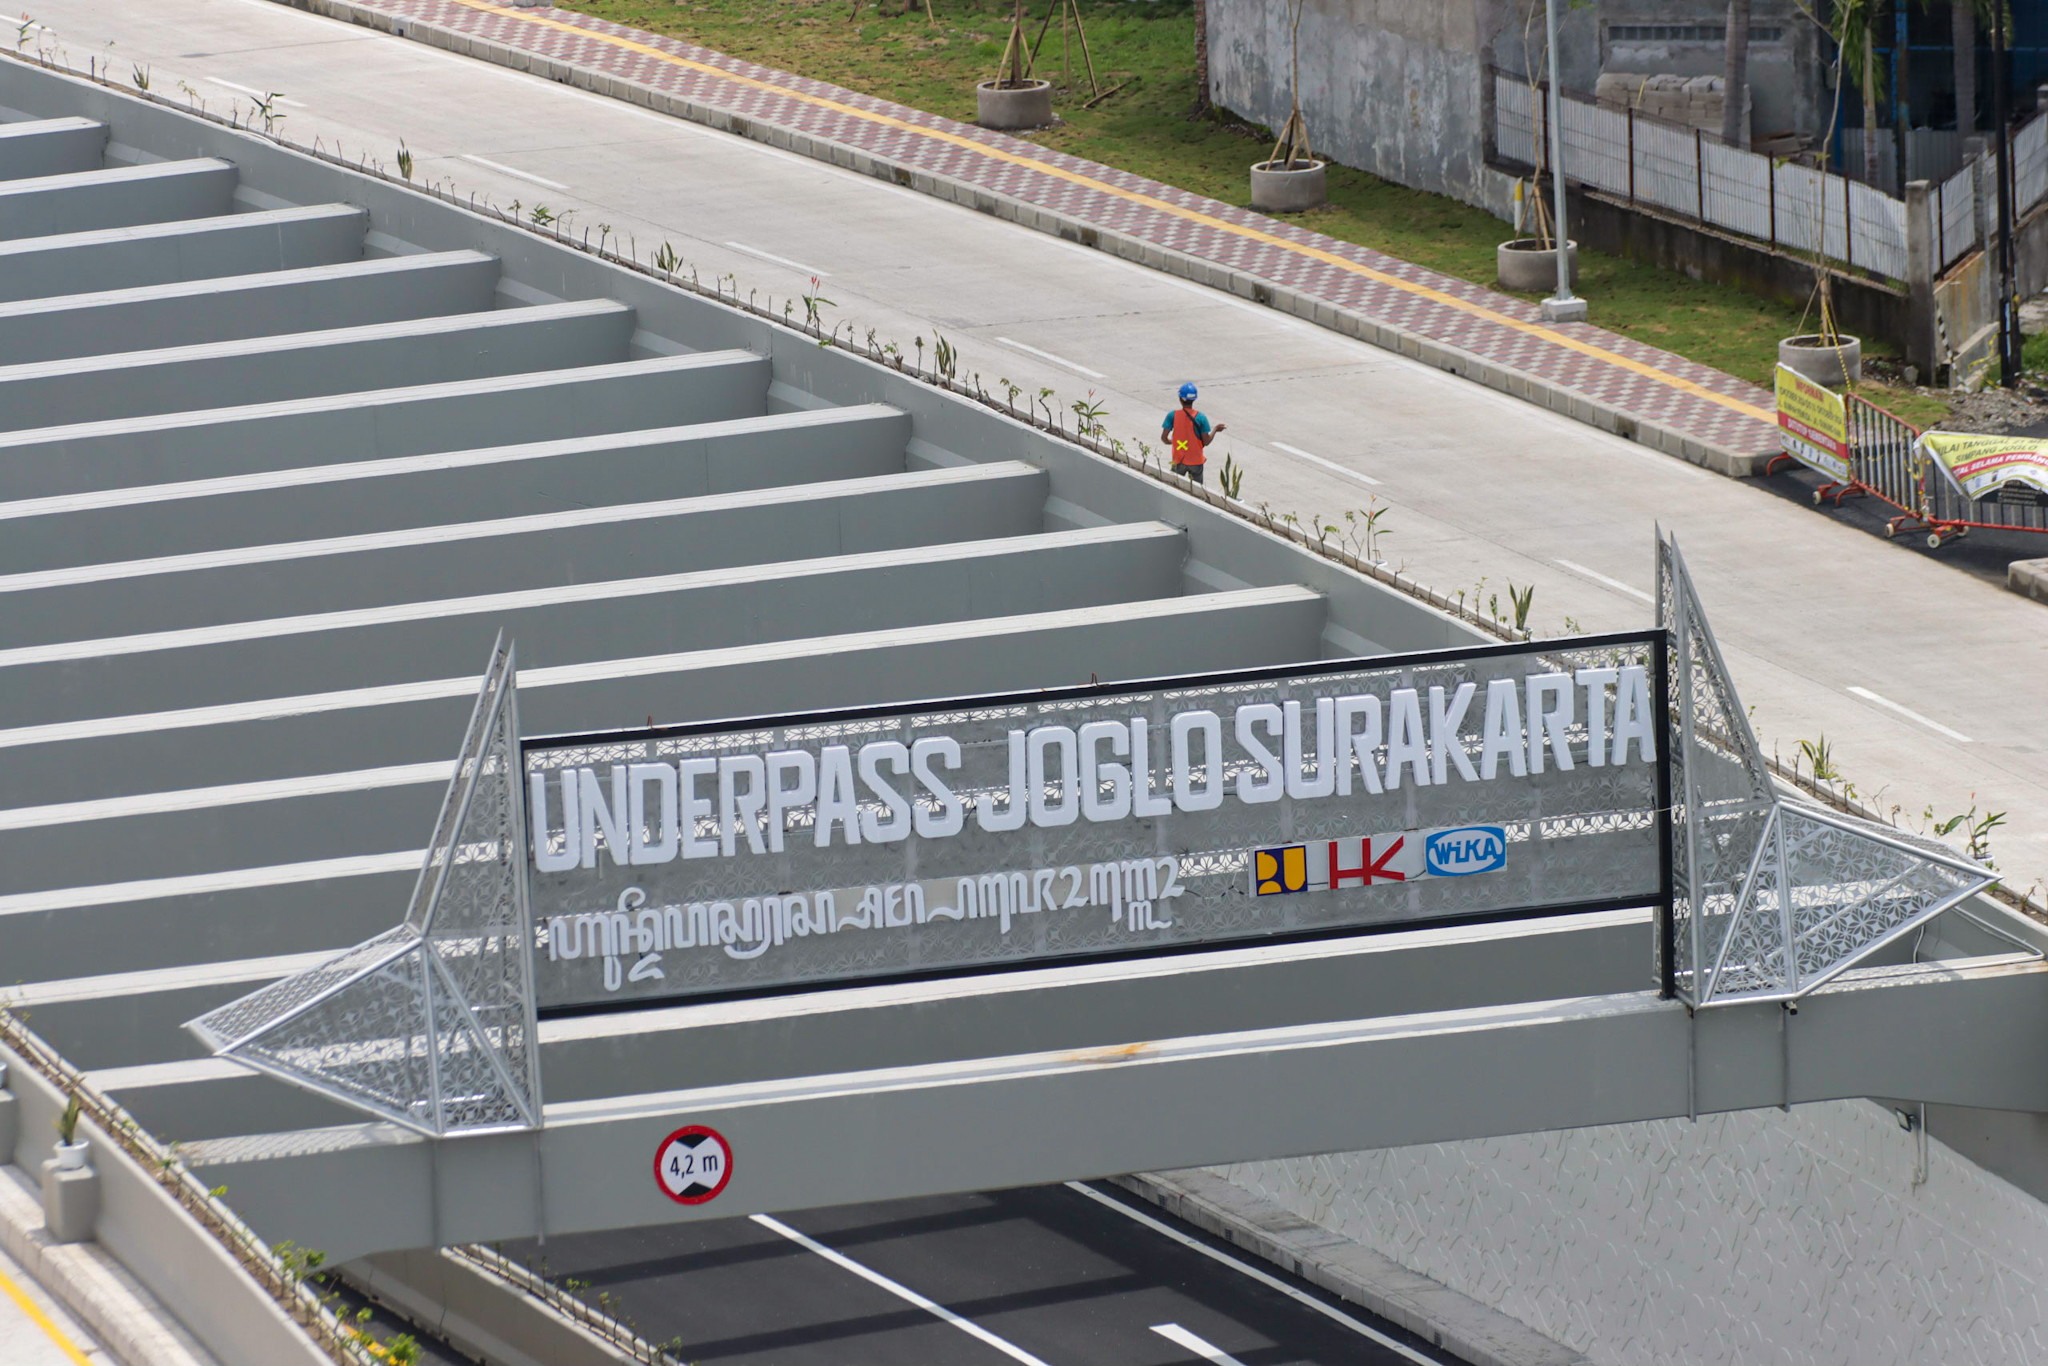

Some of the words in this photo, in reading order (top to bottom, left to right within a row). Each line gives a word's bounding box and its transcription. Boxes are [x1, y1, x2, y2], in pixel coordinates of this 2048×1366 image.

[1955, 446, 1996, 463] SIMPANG
[1998, 445, 2038, 453] JOGLO
[1963, 439, 2009, 449] TANGGAL
[1971, 456, 2003, 470] SELAMA
[529, 736, 962, 873] UNDERPASS
[976, 709, 1224, 833] JOGLO
[1236, 665, 1657, 803] SURAKARTA
[1328, 835, 1405, 889] HK
[670, 1154, 695, 1179] 4,2
[703, 1154, 718, 1172] m
